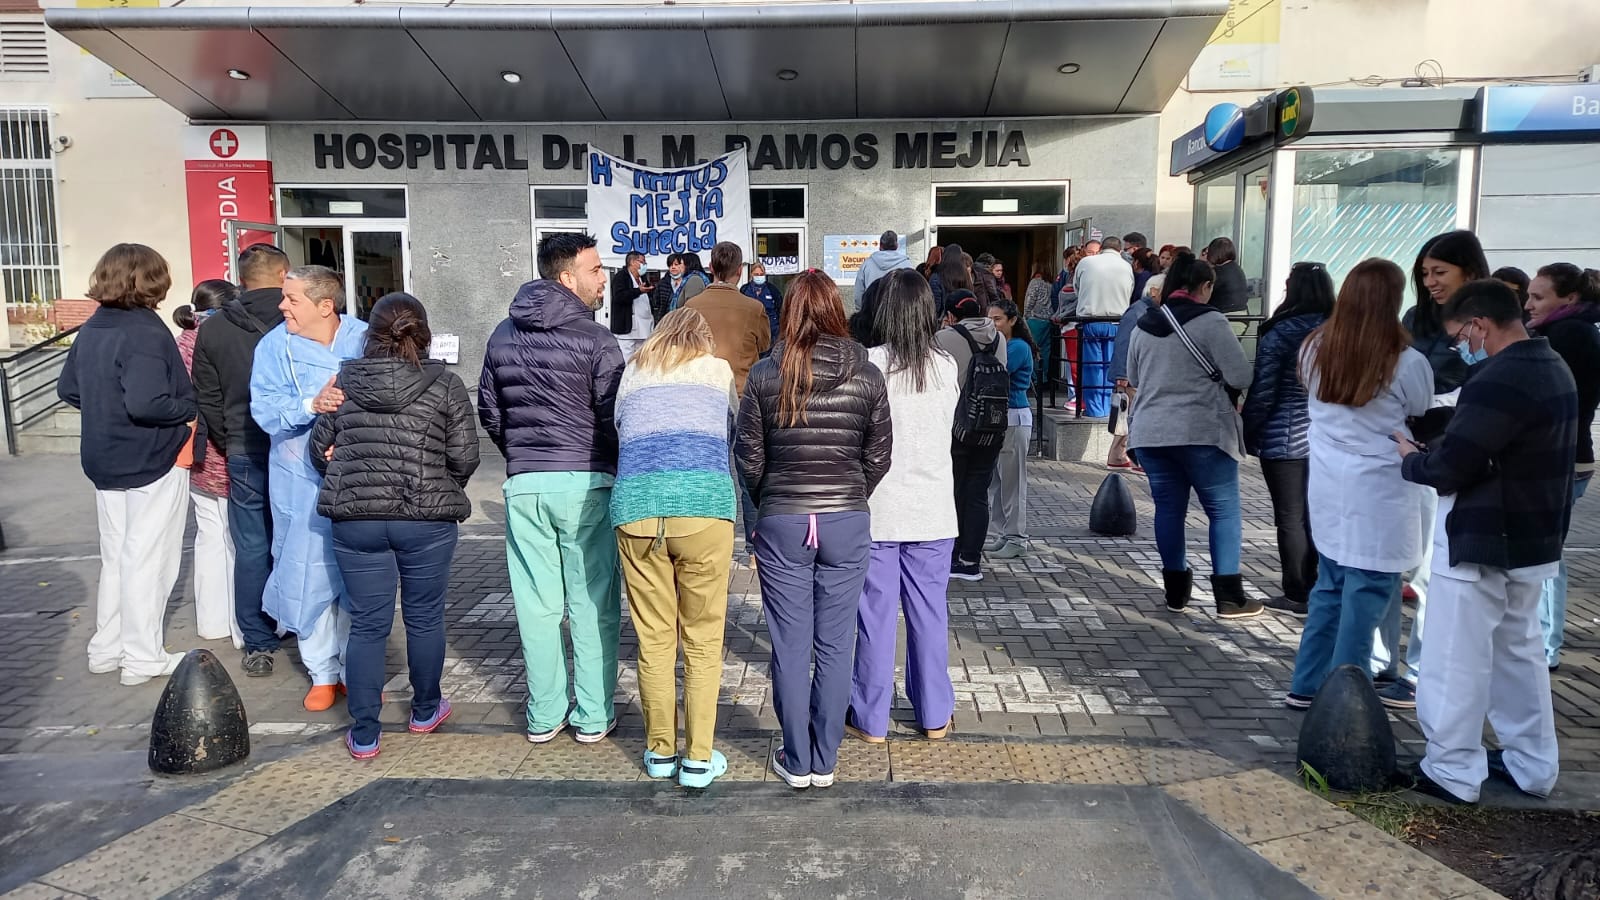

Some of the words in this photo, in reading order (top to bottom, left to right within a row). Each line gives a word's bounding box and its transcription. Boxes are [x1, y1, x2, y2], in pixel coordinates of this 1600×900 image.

[314, 133, 528, 170] HOSPITAL
[725, 132, 878, 170] RAMOS
[893, 130, 1032, 169] MEJIA
